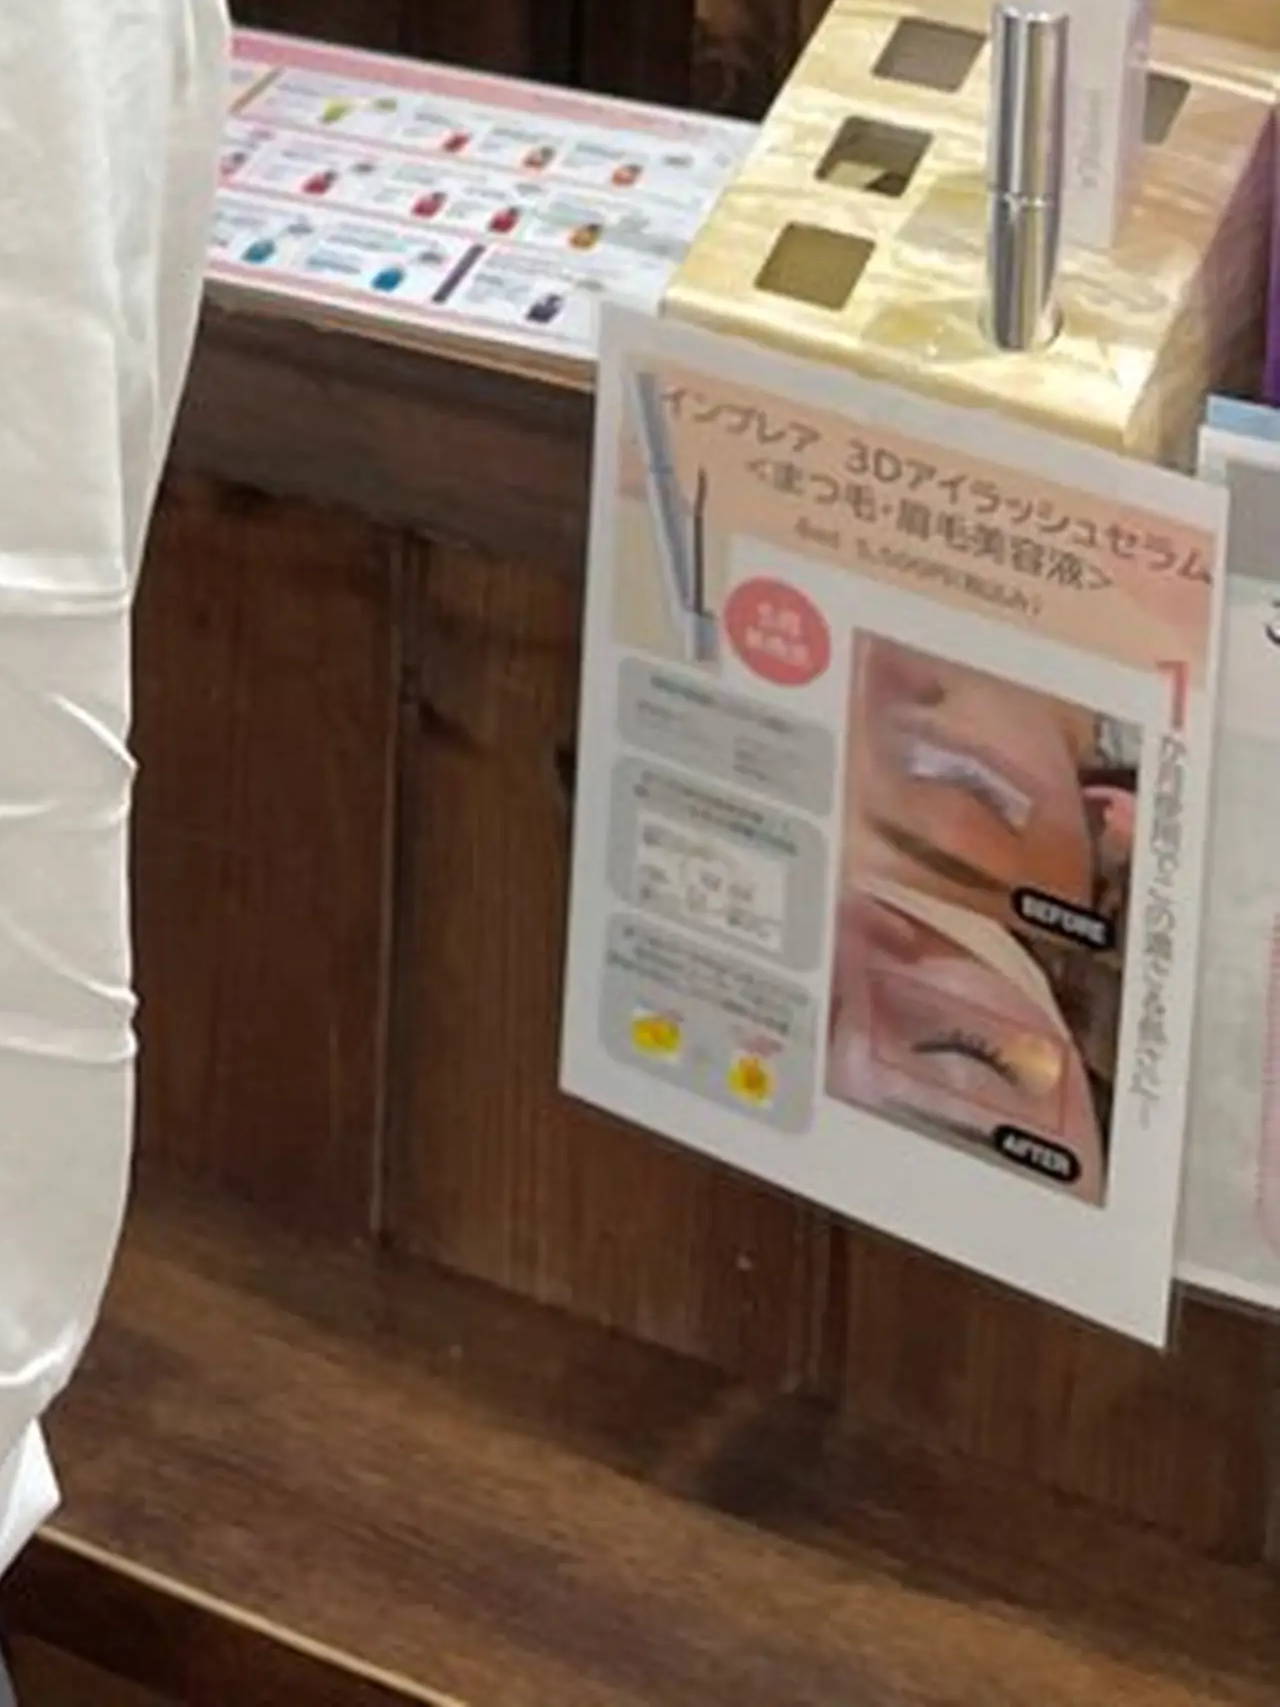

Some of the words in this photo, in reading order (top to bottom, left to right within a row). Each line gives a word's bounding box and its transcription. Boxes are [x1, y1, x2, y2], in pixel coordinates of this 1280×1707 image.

[842, 437, 1214, 585] 3Dアイラッシュセラム
[1021, 895, 1106, 945] BEFORE
[1001, 1133, 1071, 1176] AFTER
